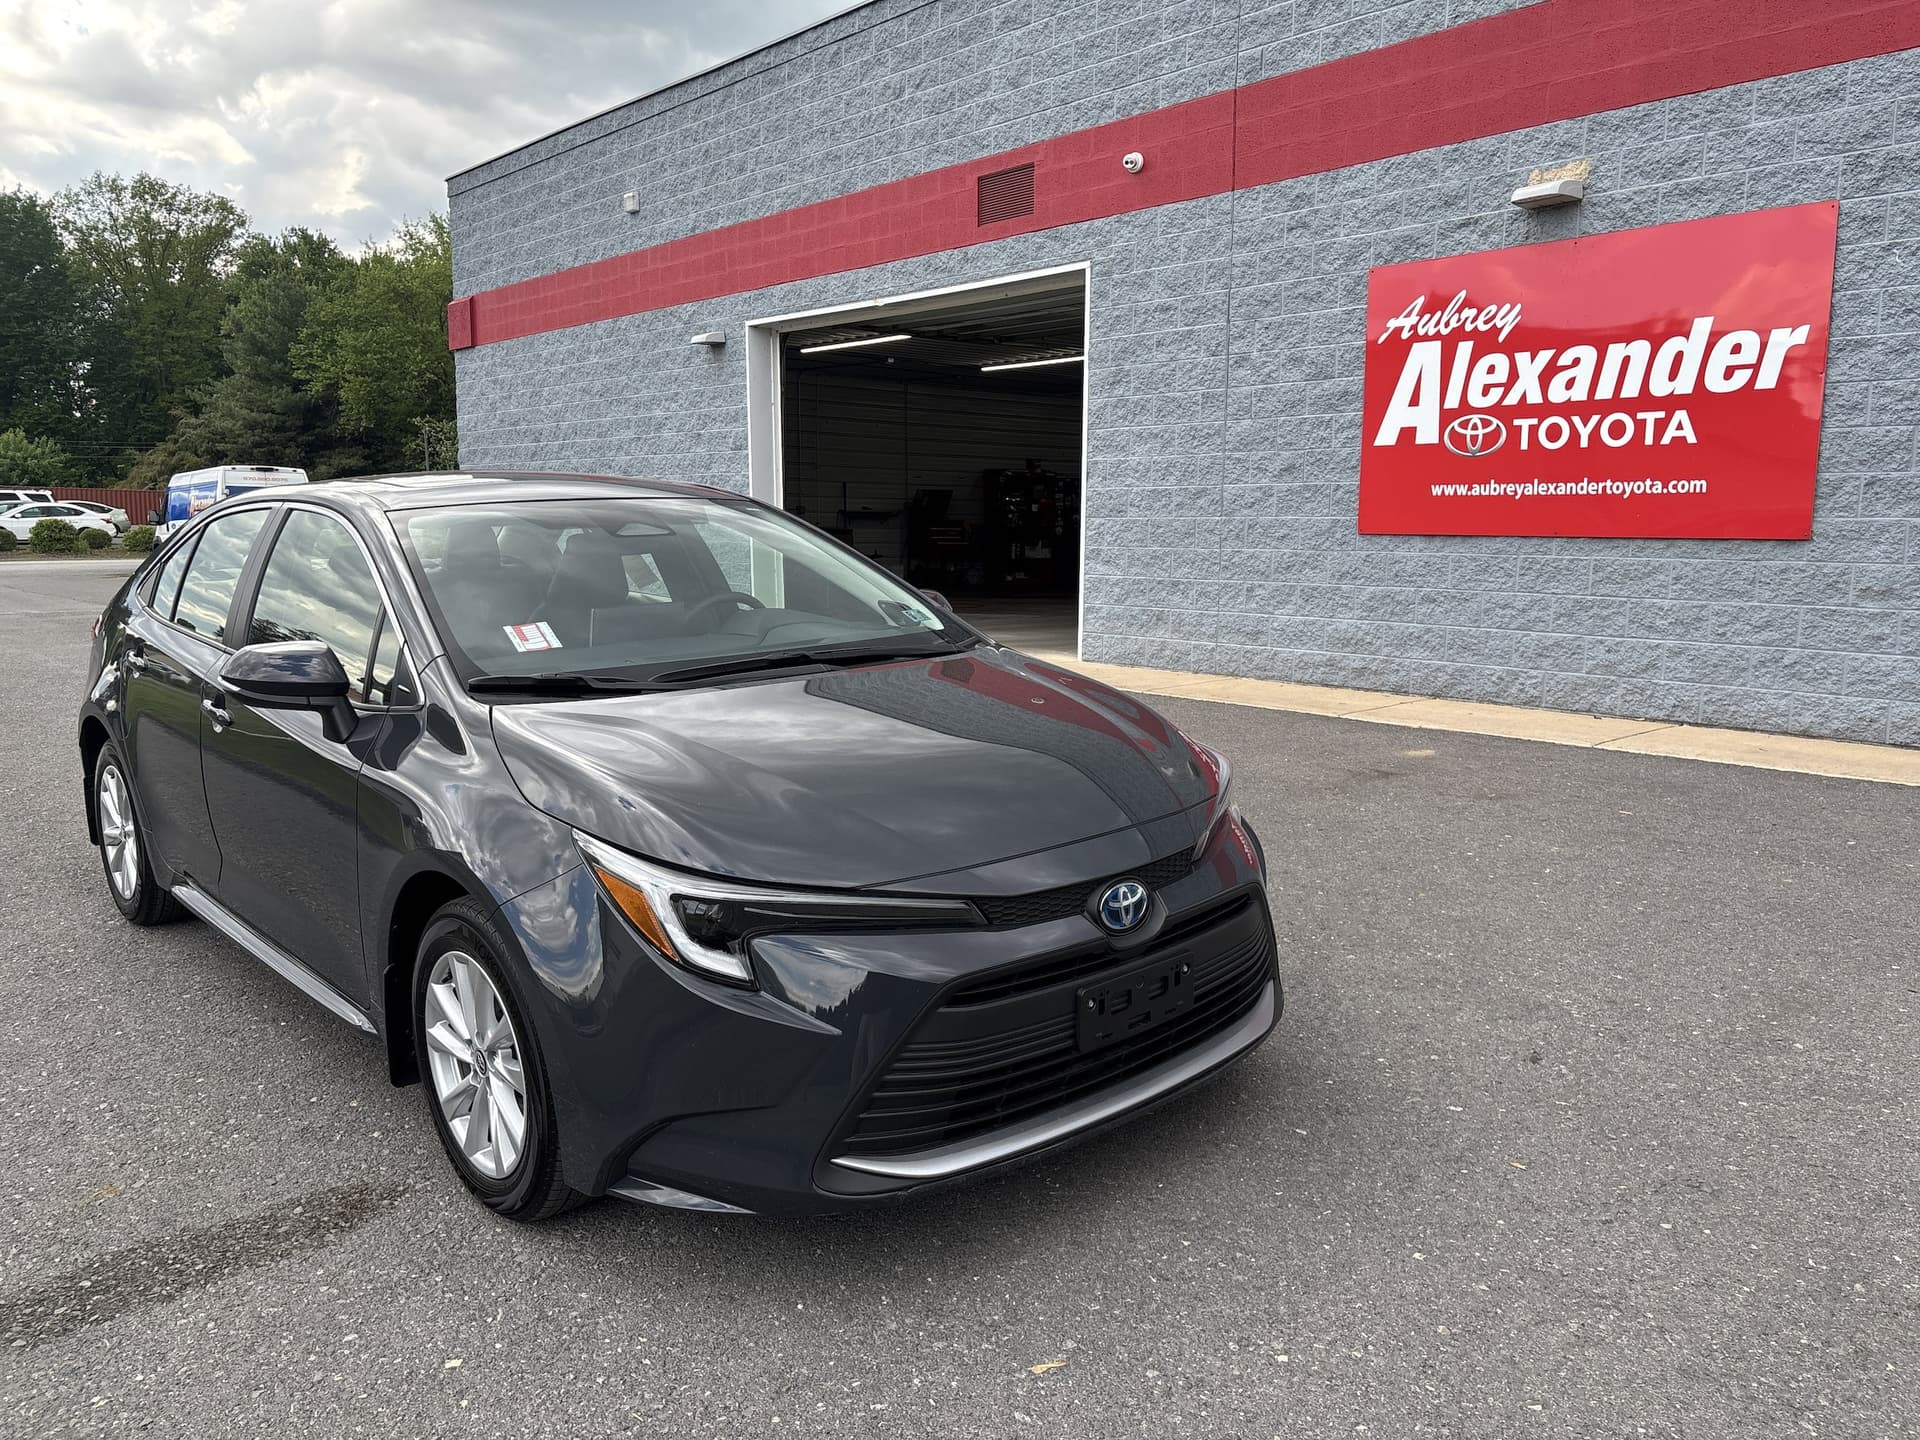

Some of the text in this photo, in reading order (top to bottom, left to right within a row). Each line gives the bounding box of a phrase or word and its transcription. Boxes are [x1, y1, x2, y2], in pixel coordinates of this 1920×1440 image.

[1378, 290, 1522, 344] Aubrey
[1374, 317, 1810, 446] Alexander
[1513, 409, 1697, 450] TOYOTA
[1431, 477, 1707, 499] www.aubreyalexandertoyota.com
